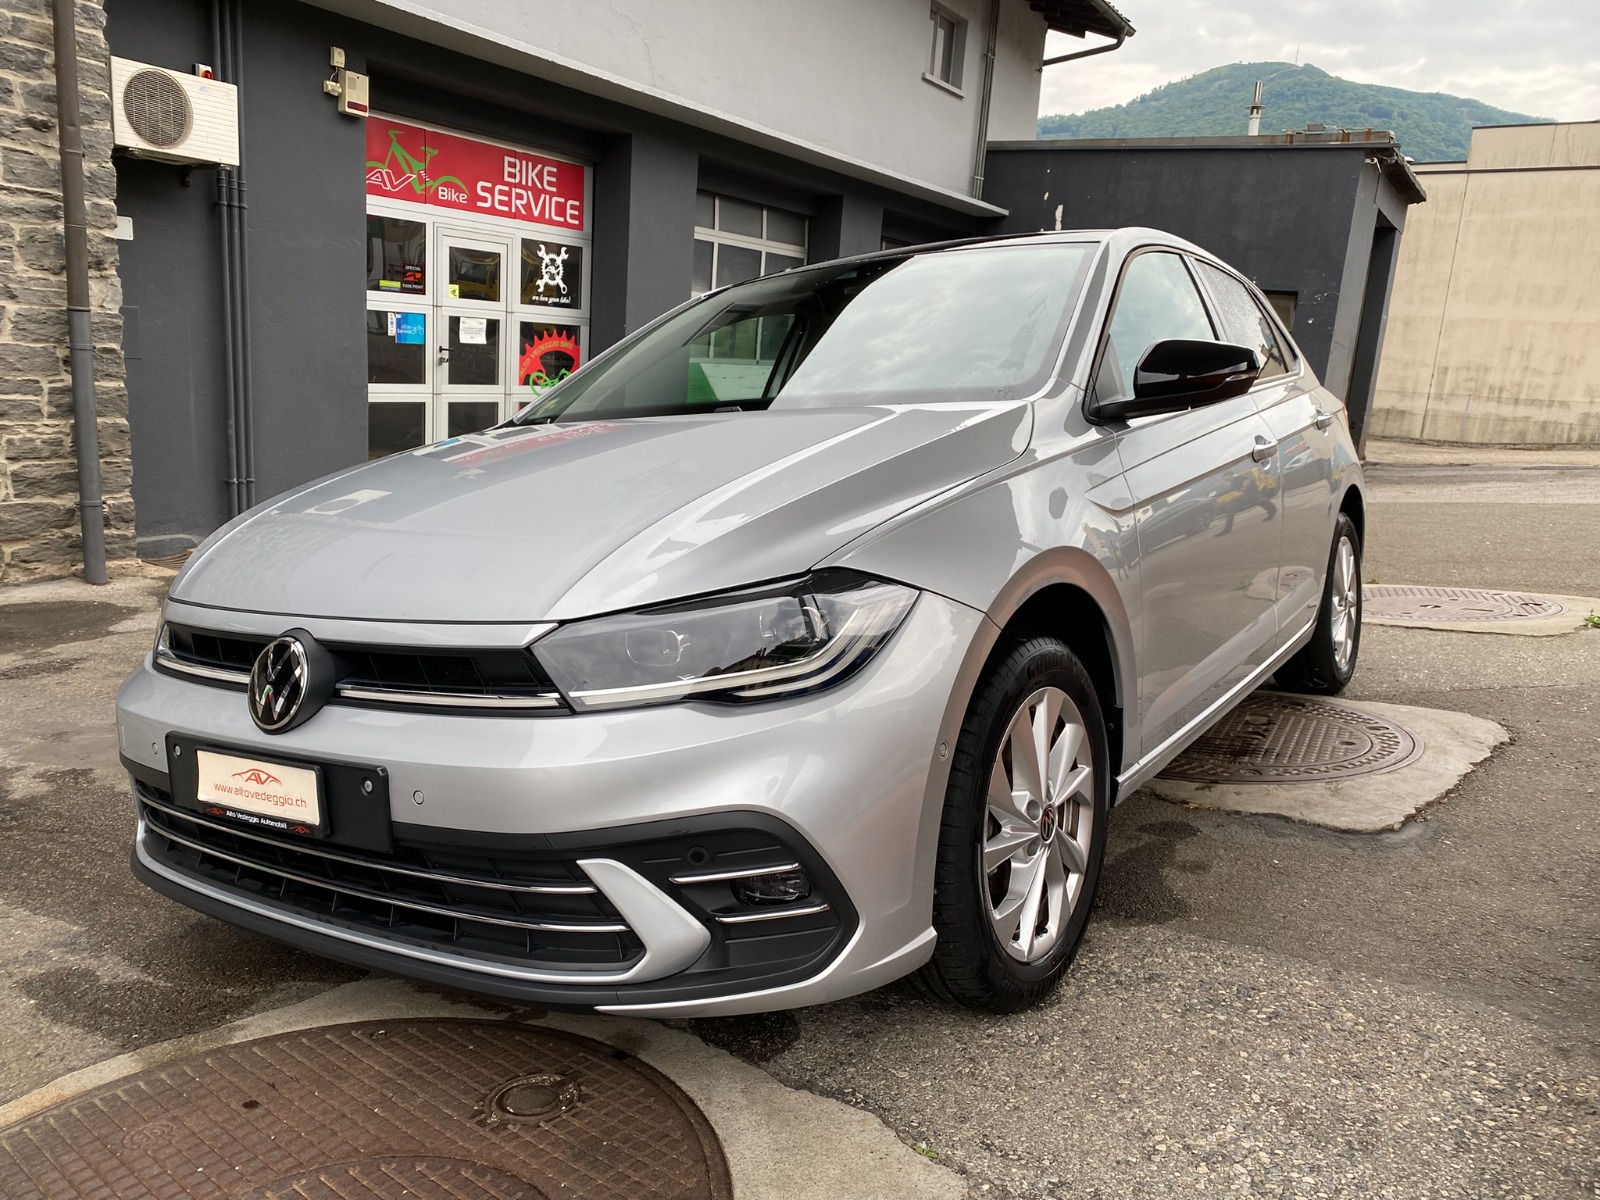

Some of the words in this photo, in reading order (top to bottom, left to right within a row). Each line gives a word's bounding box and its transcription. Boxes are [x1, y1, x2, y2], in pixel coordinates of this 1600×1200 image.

[503, 156, 557, 192] BIKE
[438, 186, 468, 204] Bike
[476, 181, 580, 225] SERVICE
[244, 771, 271, 785] AV
[213, 783, 307, 808] www.altovedeggio.ch
[226, 810, 236, 818] Alto
[236, 812, 260, 823] Vedeggio
[260, 817, 288, 829] Automobili
